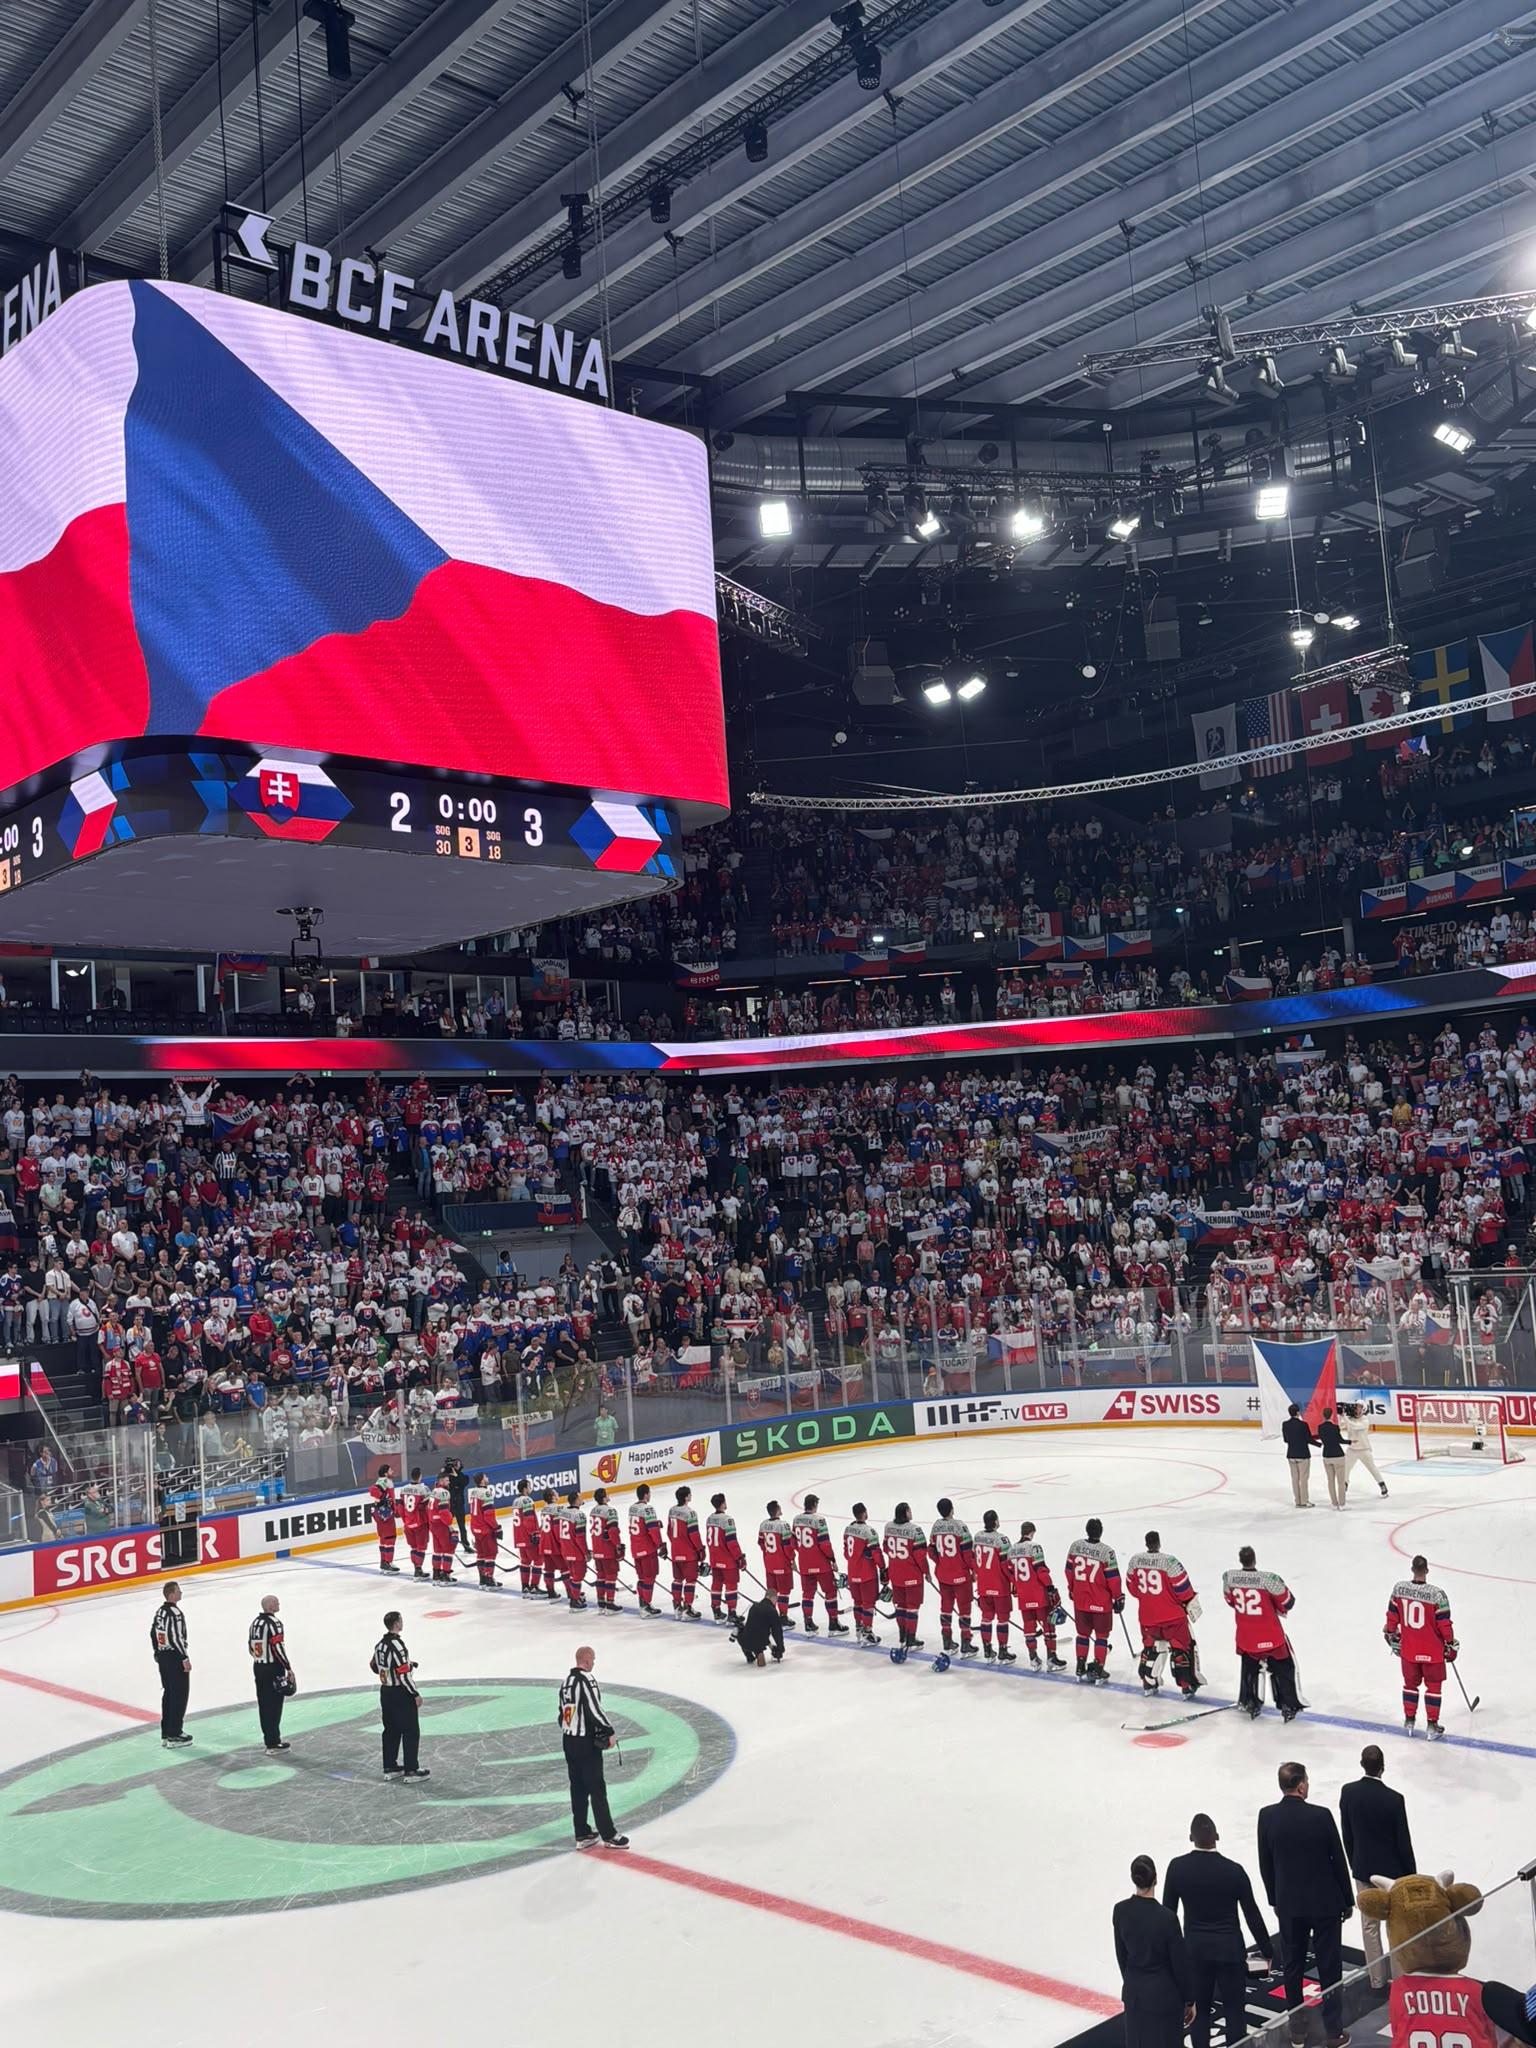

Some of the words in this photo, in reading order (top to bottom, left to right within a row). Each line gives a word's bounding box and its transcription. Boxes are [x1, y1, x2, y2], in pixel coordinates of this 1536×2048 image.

[289, 241, 415, 331] BCF
[423, 289, 608, 397] ARENA
[390, 792, 412, 833] 2
[439, 794, 497, 823] 0:00
[0, 824, 19, 854] :00
[32, 816, 43, 858] 3
[435, 825, 451, 836] SOG
[486, 831, 501, 841] SOG
[524, 808, 544, 846] 3
[436, 840, 451, 855] 30
[465, 836, 473, 852] 3
[488, 845, 501, 859] 18
[1438, 921, 1457, 935] TO
[690, 973, 720, 984] BRNO
[1024, 1405, 1066, 1420] LIVE
[1140, 1393, 1221, 1415] SWISS
[361, 1431, 402, 1443] FRYDLAN
[628, 1446, 674, 1464] Happiness
[634, 1466, 644, 1476] at
[265, 1503, 375, 1542] LIEBHER
[795, 1526, 814, 1548] 96
[887, 1536, 909, 1560] 95
[56, 1539, 137, 1587] SRG
[146, 1526, 220, 1570] SR
[975, 1543, 995, 1570] 87
[1074, 1556, 1100, 1584] 27
[1137, 1568, 1163, 1595] 39
[1232, 1588, 1263, 1616] 32
[1401, 1598, 1425, 1629] 10
[1404, 1990, 1469, 2017] COOLY
